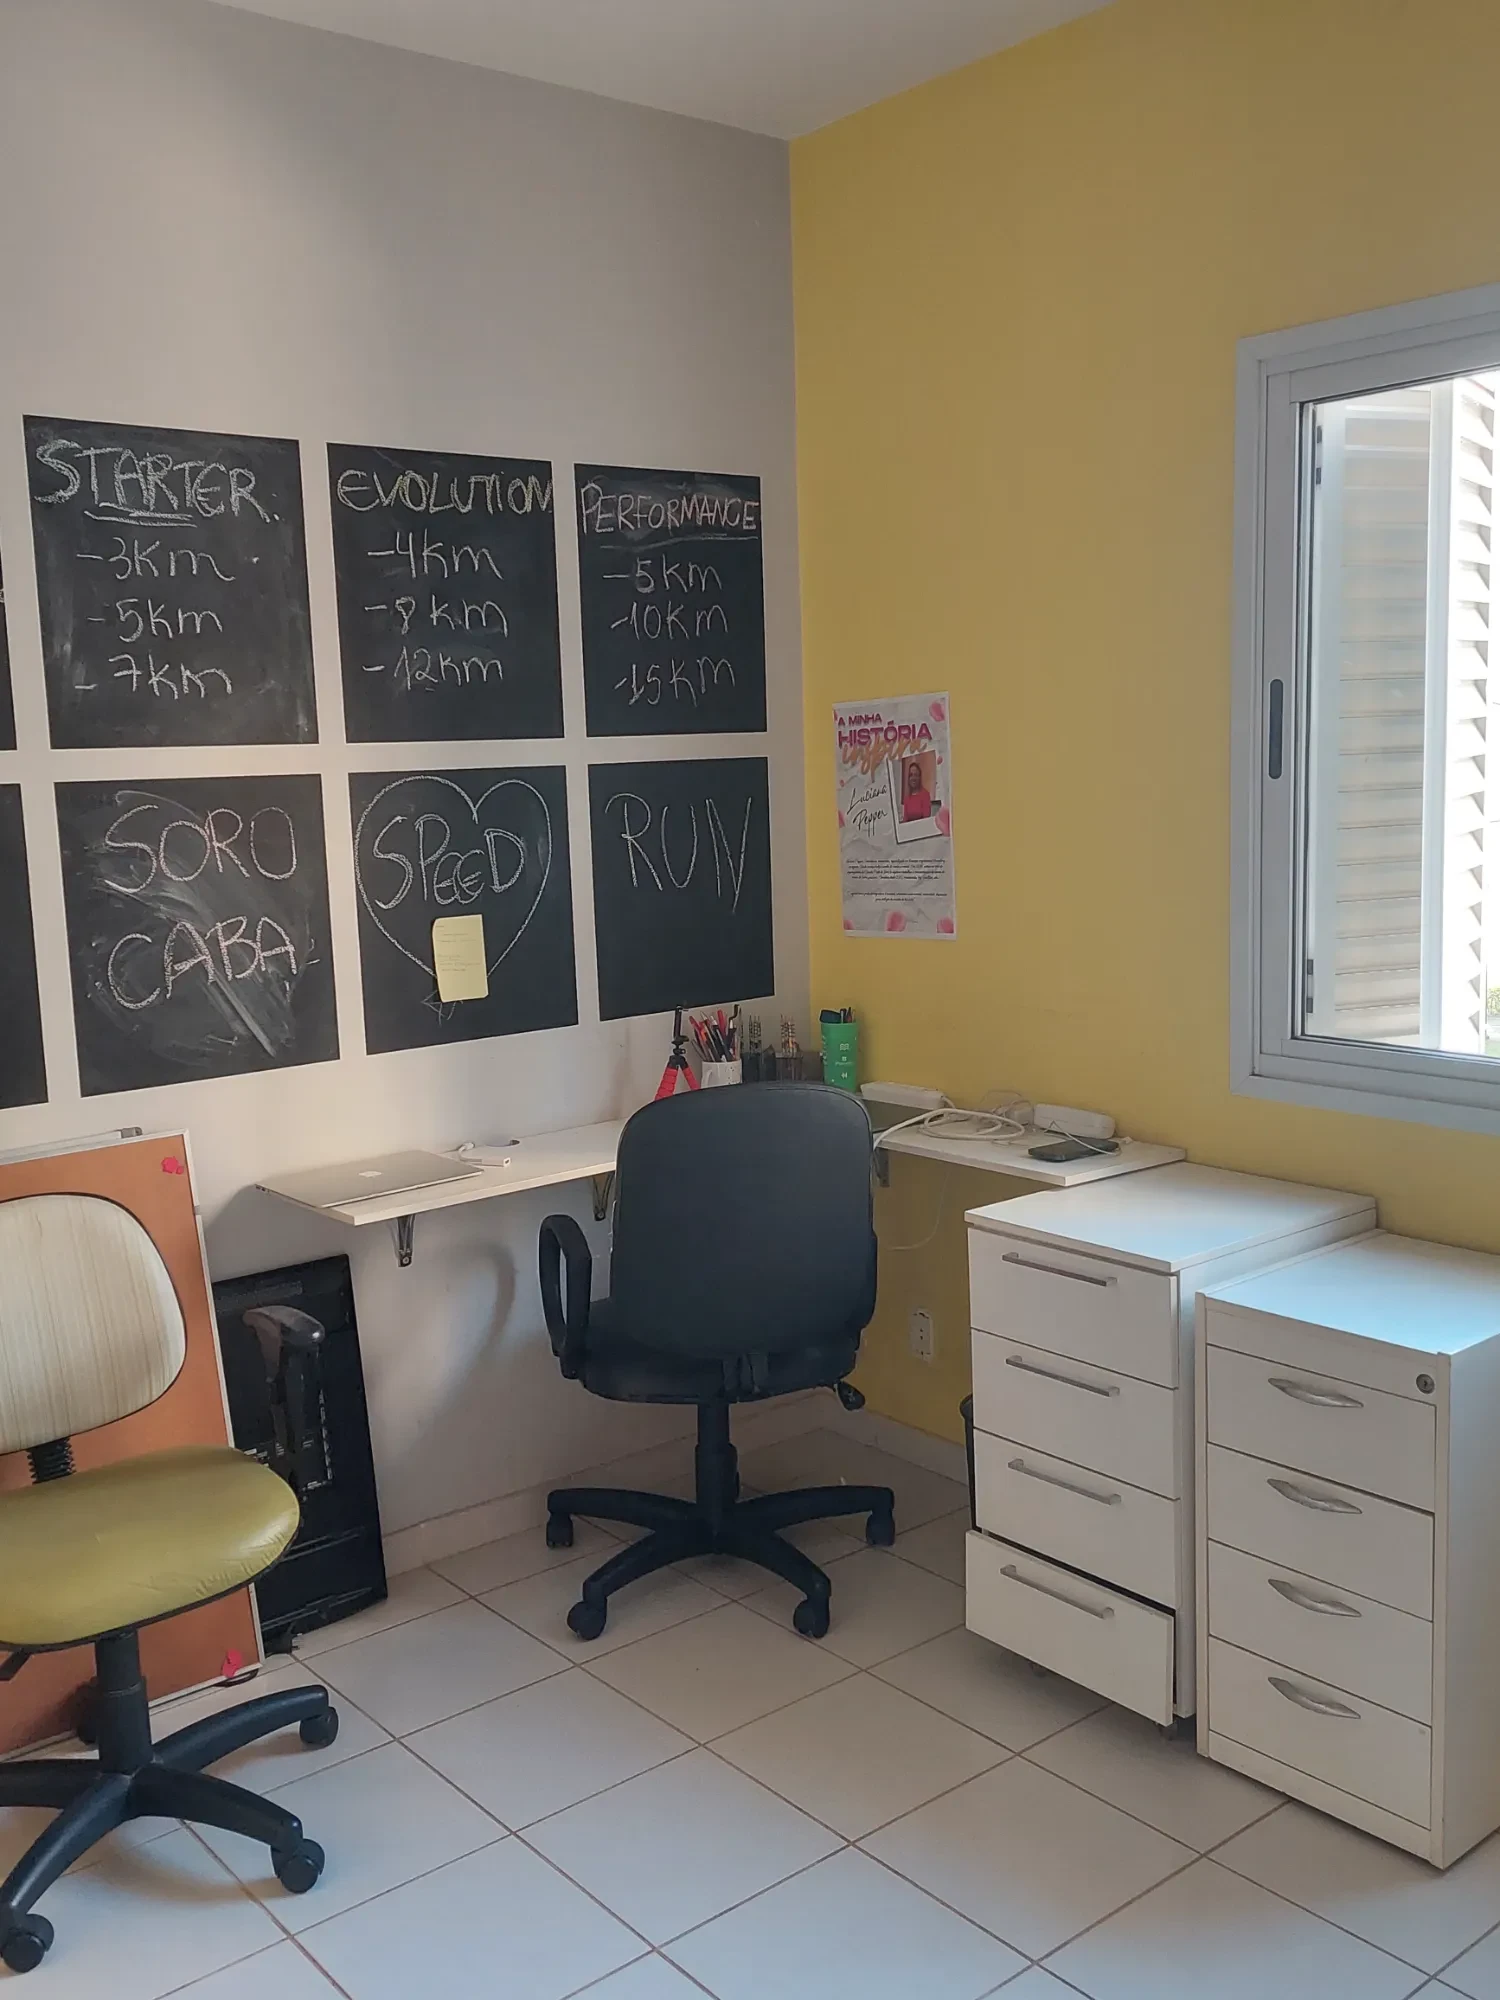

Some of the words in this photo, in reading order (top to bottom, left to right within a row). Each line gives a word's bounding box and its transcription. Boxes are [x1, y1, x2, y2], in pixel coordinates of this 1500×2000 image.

[337, 469, 553, 515] EVOLUTION
[581, 480, 760, 536] PERFORMANCE
[838, 717, 846, 726] A
[848, 713, 882, 726] MINHA
[838, 720, 932, 748] HISTÓRIA
[105, 804, 297, 893] SORO
[605, 793, 752, 914] RUN
[107, 915, 298, 1010] CABA
